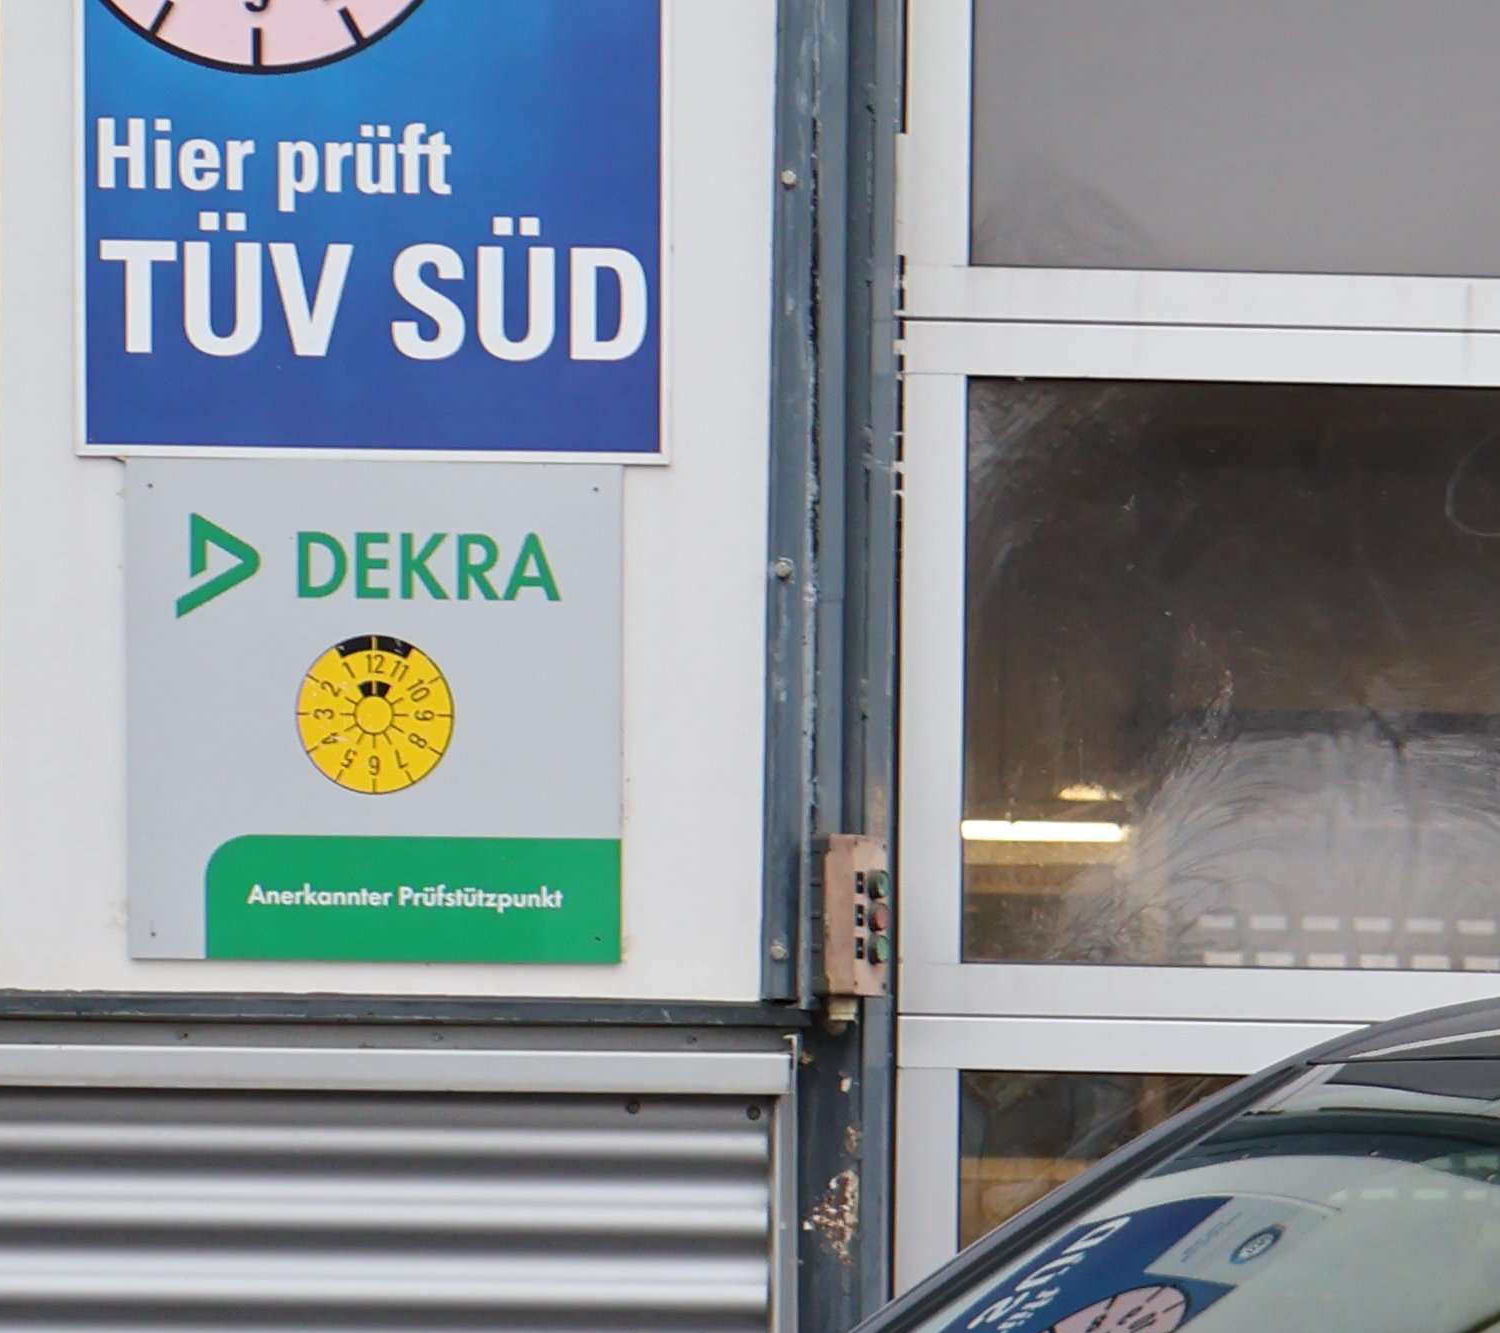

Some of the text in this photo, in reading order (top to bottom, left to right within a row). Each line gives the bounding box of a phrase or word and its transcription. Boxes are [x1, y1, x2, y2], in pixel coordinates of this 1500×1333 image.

[97, 117, 452, 213] Hier prüft
[100, 211, 649, 362] TÜV SÜD
[296, 531, 561, 602] DEKRA
[246, 882, 565, 914] Anerkannter Prüfstützpunkt
